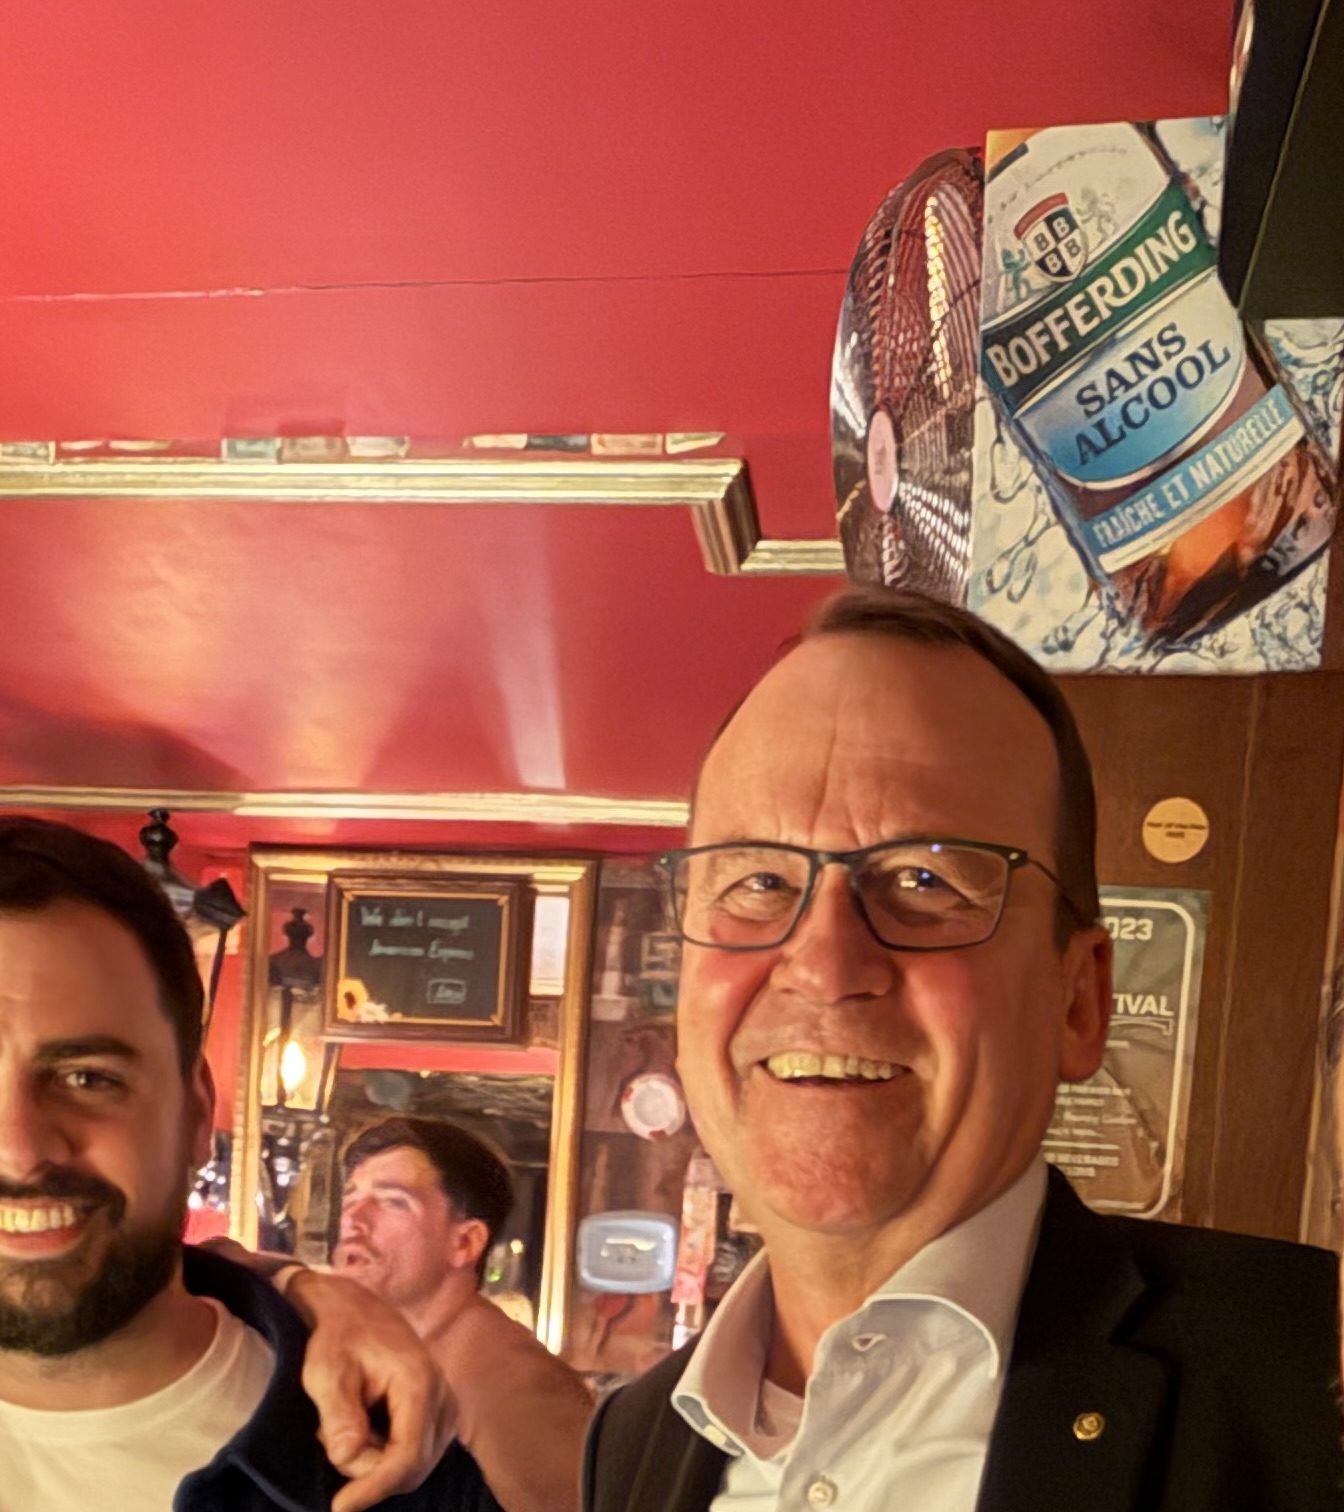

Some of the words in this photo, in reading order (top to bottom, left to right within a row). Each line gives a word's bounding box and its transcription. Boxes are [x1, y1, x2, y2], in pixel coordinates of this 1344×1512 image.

[986, 210, 1197, 388] BOFFERDING
[1075, 339, 1231, 466] ALCOOL
[1076, 322, 1187, 419] SANS
[1161, 474, 1192, 510] ET
[1188, 398, 1285, 490] NATURELLE
[1104, 916, 1153, 941] 023
